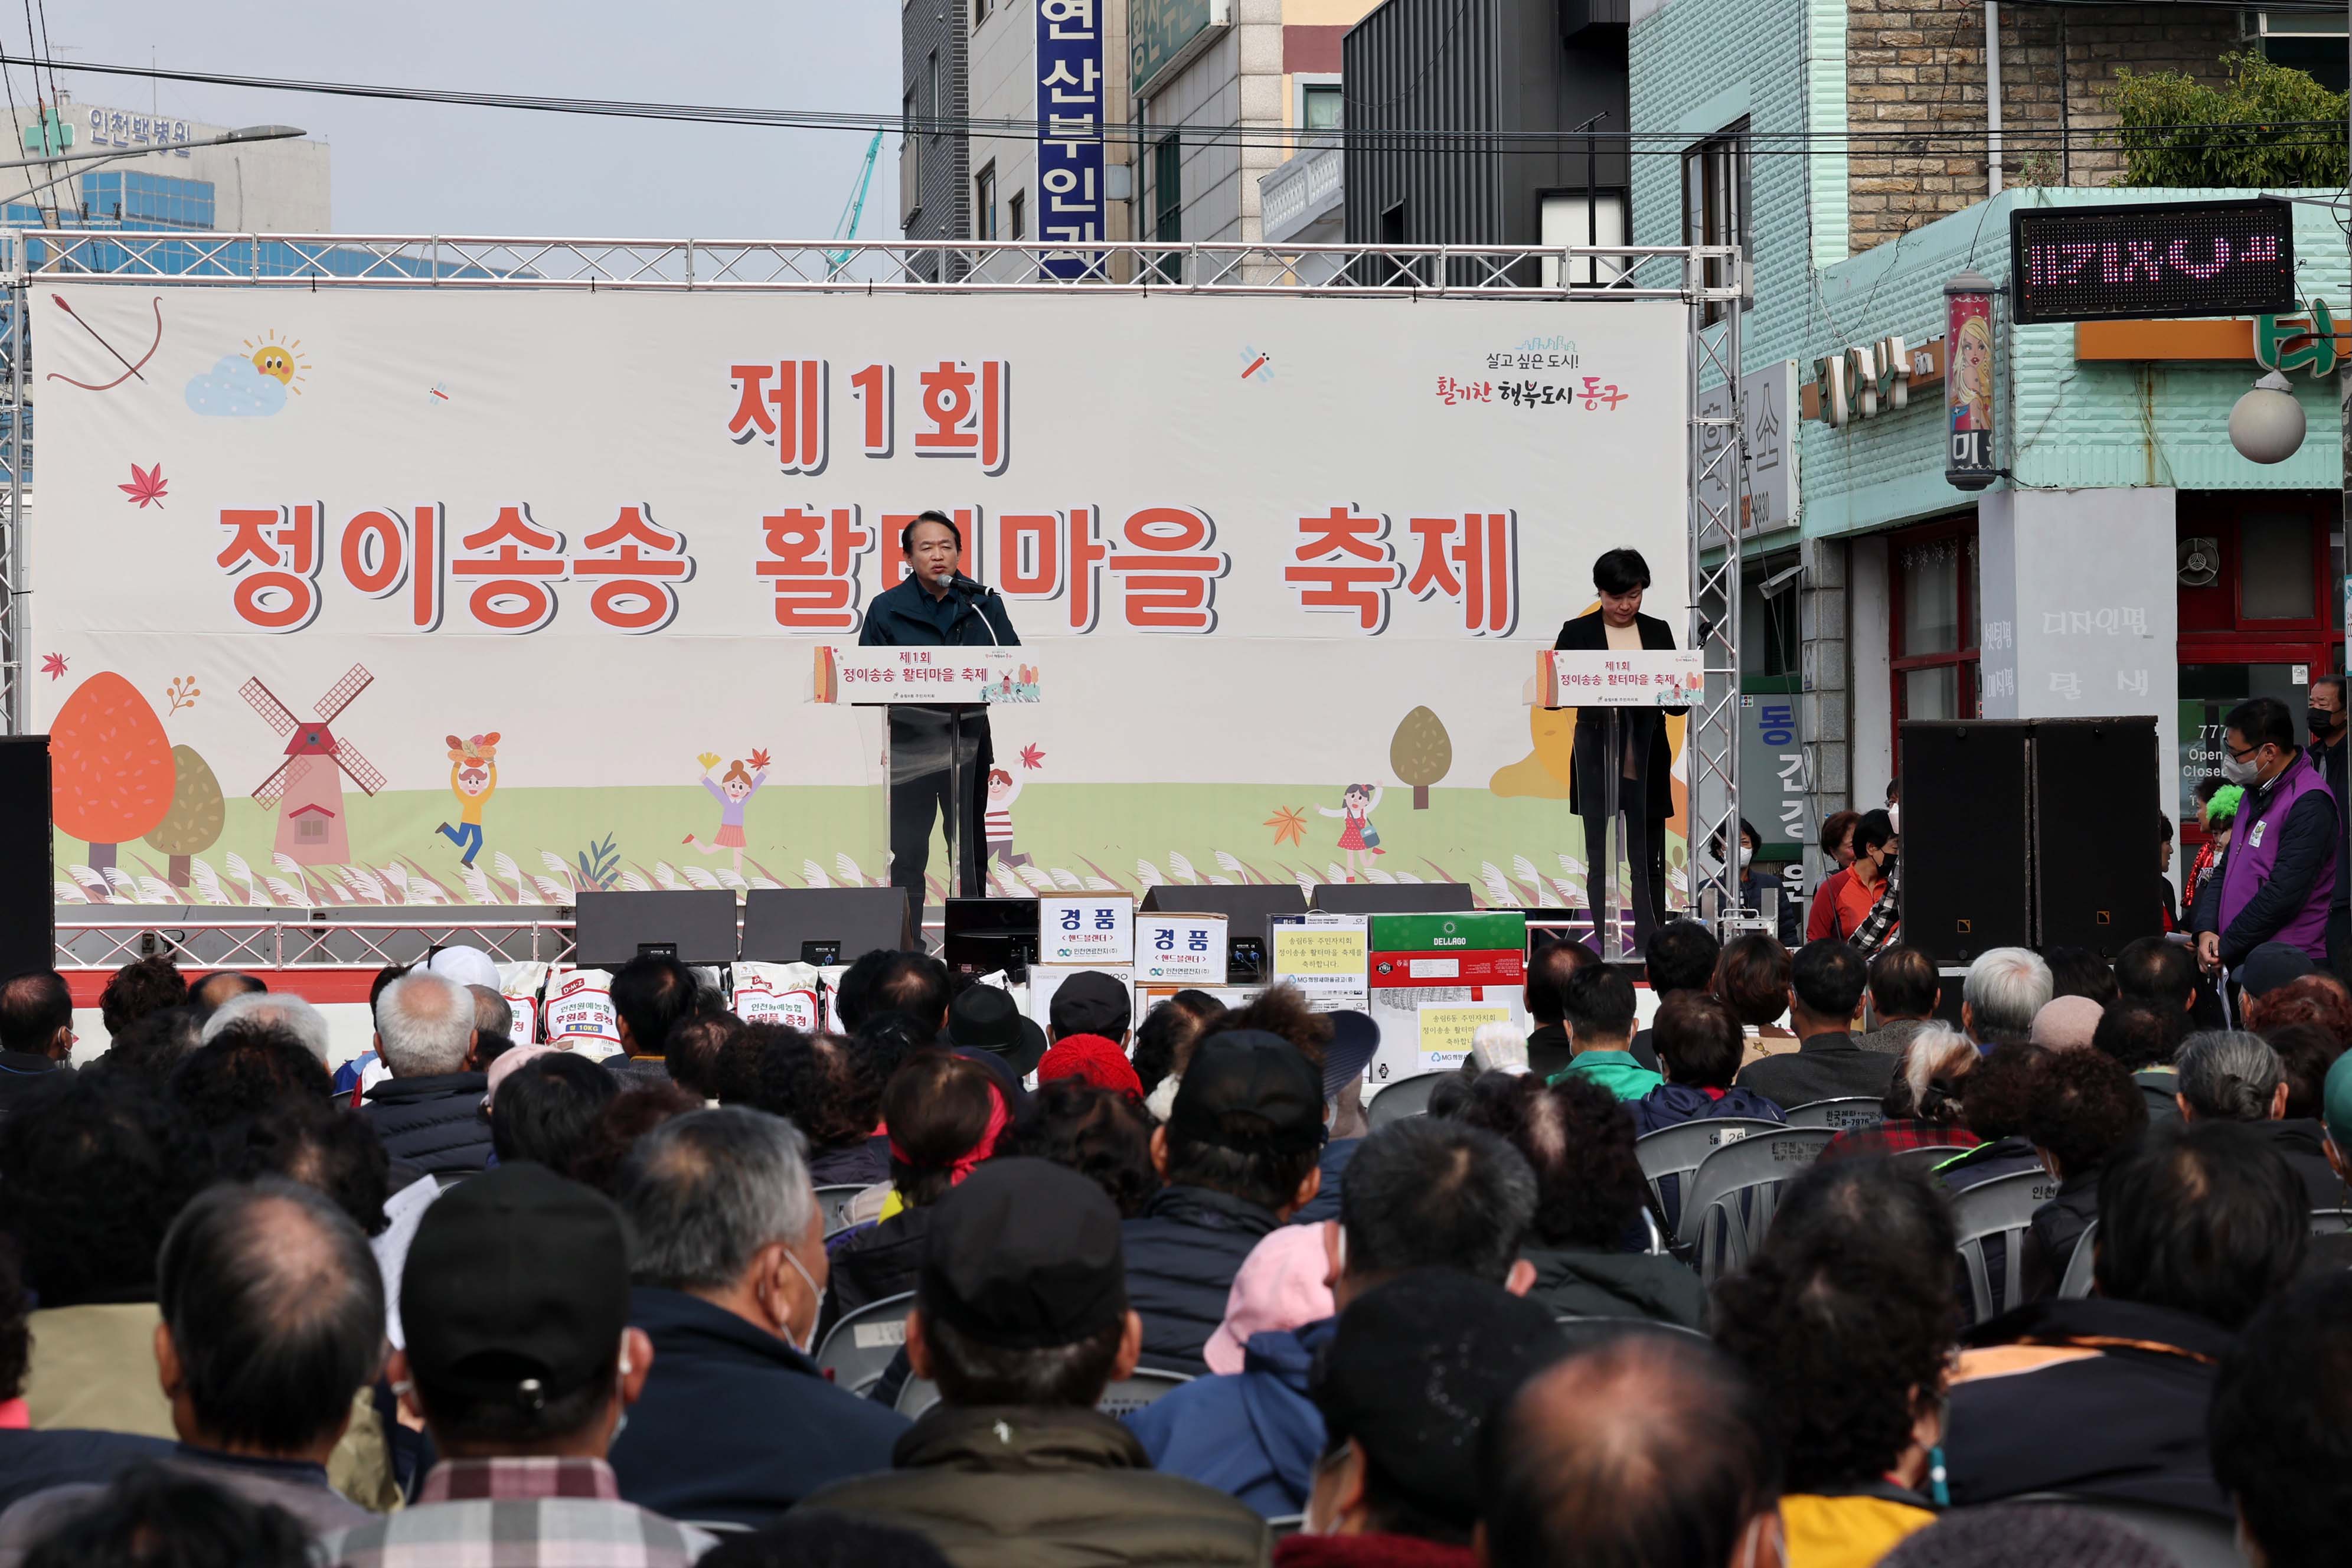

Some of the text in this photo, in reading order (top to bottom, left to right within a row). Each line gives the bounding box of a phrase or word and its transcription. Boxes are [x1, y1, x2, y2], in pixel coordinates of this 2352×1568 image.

[1487, 353, 1579, 370] 살고 싶은 도시!
[1436, 375, 1629, 411] 활기찬 행복도시 동구
[727, 360, 1010, 476] 제1회
[217, 504, 697, 635] 정이송송
[1286, 508, 1521, 638] 축제
[2042, 606, 2148, 635] 디자인펌
[899, 651, 931, 664] 제1회
[1605, 661, 1631, 671] 제1회
[842, 668, 988, 682] 정이송송 활터마을 축제
[1560, 674, 1675, 686] 정이송송 활터마을 축제
[1987, 668, 2014, 698] 매직펌
[2188, 749, 2223, 762] Open
[1433, 937, 1466, 946] DELLAGO
[561, 1002, 610, 1014] 인천원예농협
[752, 1003, 802, 1013] 인천원예농협
[556, 1012, 613, 1025] 후원품 증정
[785, 1014, 806, 1027] 증정
[1461, 1014, 1496, 1022] 주민자치회
